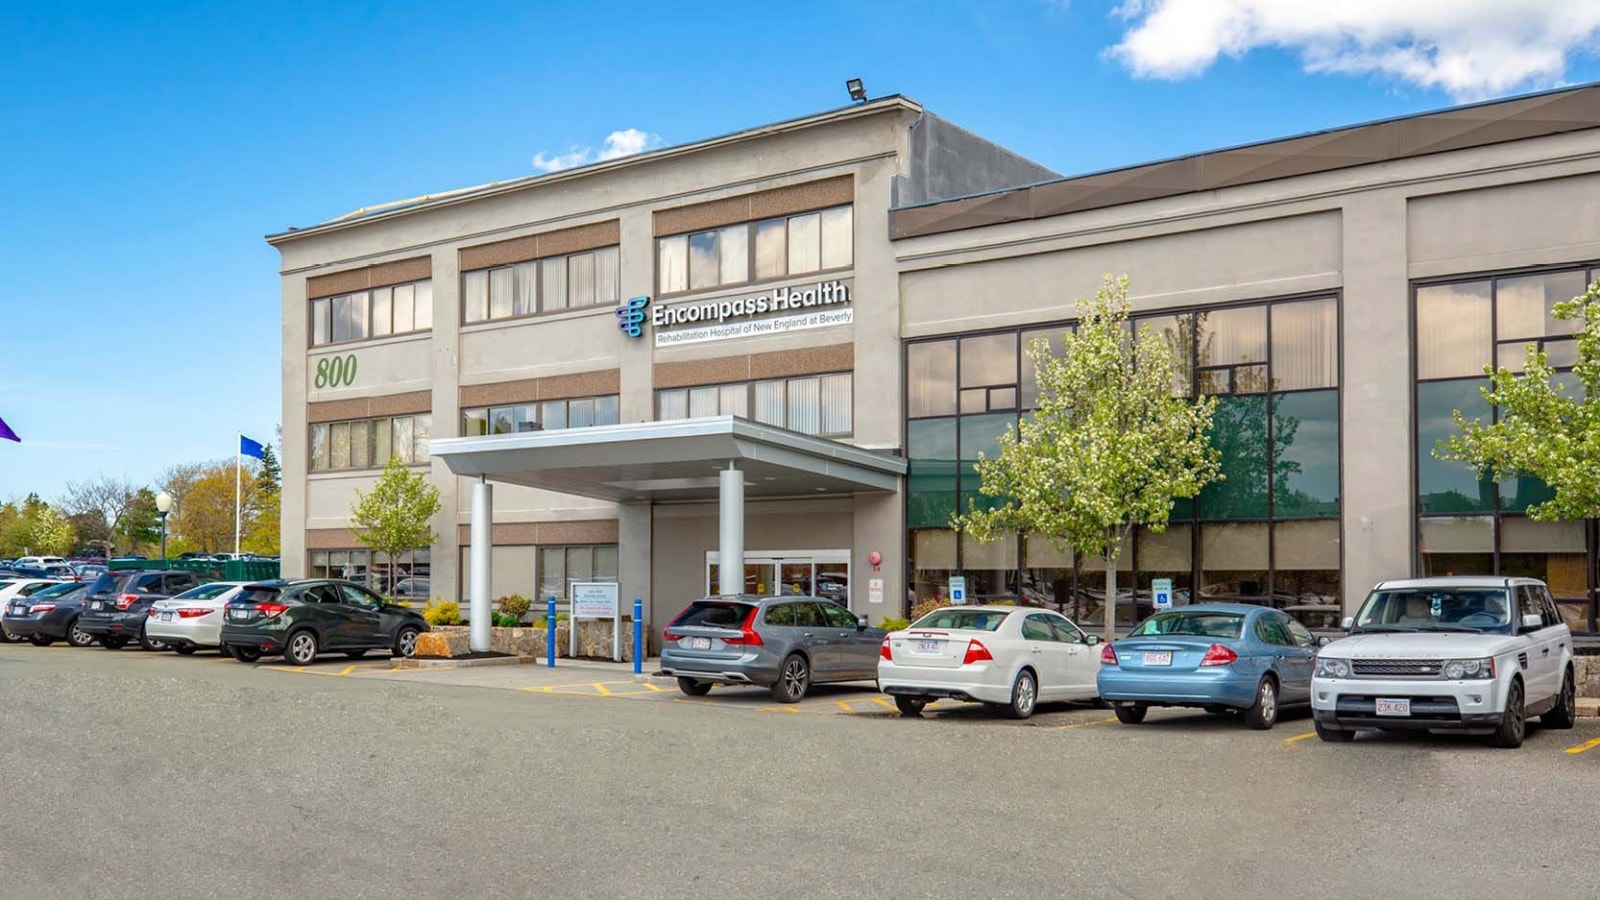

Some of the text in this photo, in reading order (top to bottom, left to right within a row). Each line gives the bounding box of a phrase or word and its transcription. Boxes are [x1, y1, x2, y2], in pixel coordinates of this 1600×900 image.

[652, 281, 847, 326] Encompass Health
[657, 312, 852, 344] Rehabilitation Hospital of New England at Beverly
[314, 354, 358, 389] 800
